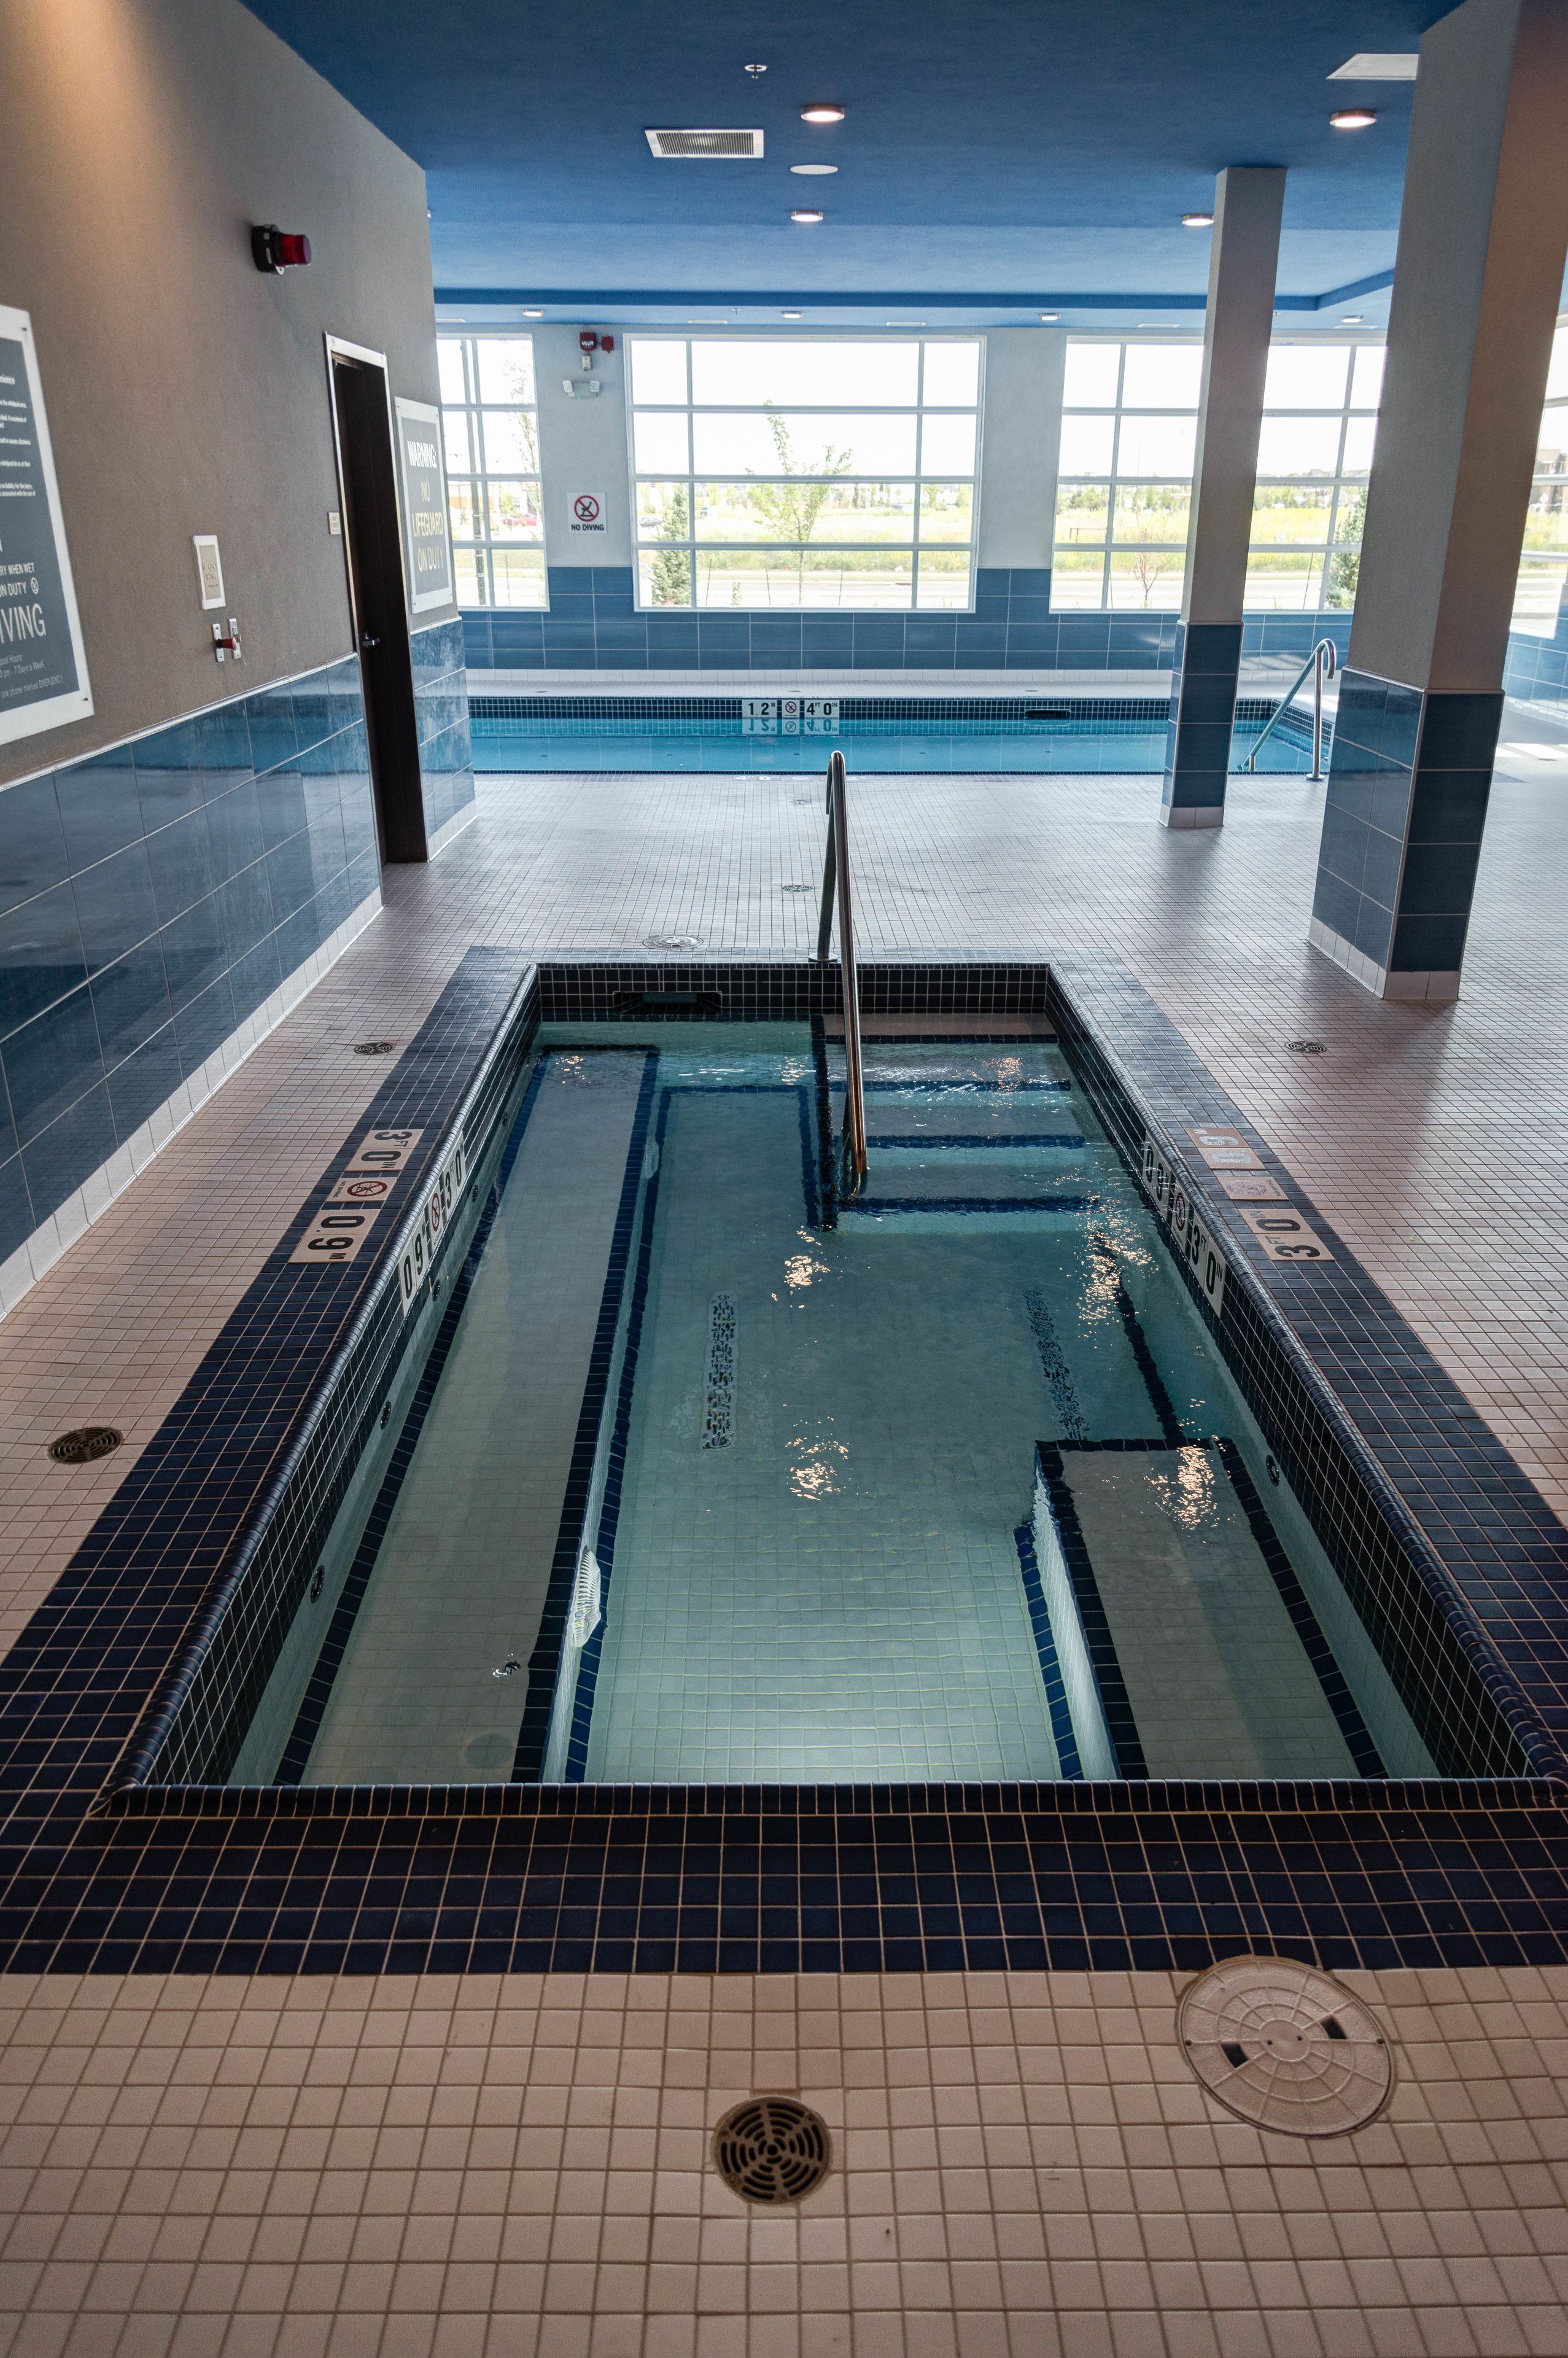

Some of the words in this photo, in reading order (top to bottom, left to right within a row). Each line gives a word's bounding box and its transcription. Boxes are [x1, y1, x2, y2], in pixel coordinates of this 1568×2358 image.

[407, 440, 437, 469] WARNING:
[421, 479, 430, 502] NO
[412, 512, 443, 537] LIFEGUARD
[417, 547, 428, 572] ON
[428, 546, 443, 570] DUTY
[8, 564, 23, 575] WHEN
[23, 562, 34, 574] WET
[8, 582, 26, 596] DUTY
[748, 702, 769, 715] 1.2
[806, 702, 815, 715] 4
[823, 702, 832, 715] 0
[373, 1131, 413, 1141] 3
[360, 1150, 402, 1162] 0
[445, 1171, 452, 1210] 3
[456, 1149, 462, 1188] 0
[1256, 1218, 1301, 1231] 0
[1265, 1235, 1284, 1245] FT
[1275, 1245, 1321, 1258] 3
[1192, 1224, 1200, 1266] 3
[1200, 1234, 1207, 1253] FT
[1206, 1250, 1216, 1295] 0
[1216, 1261, 1223, 1282] IN
